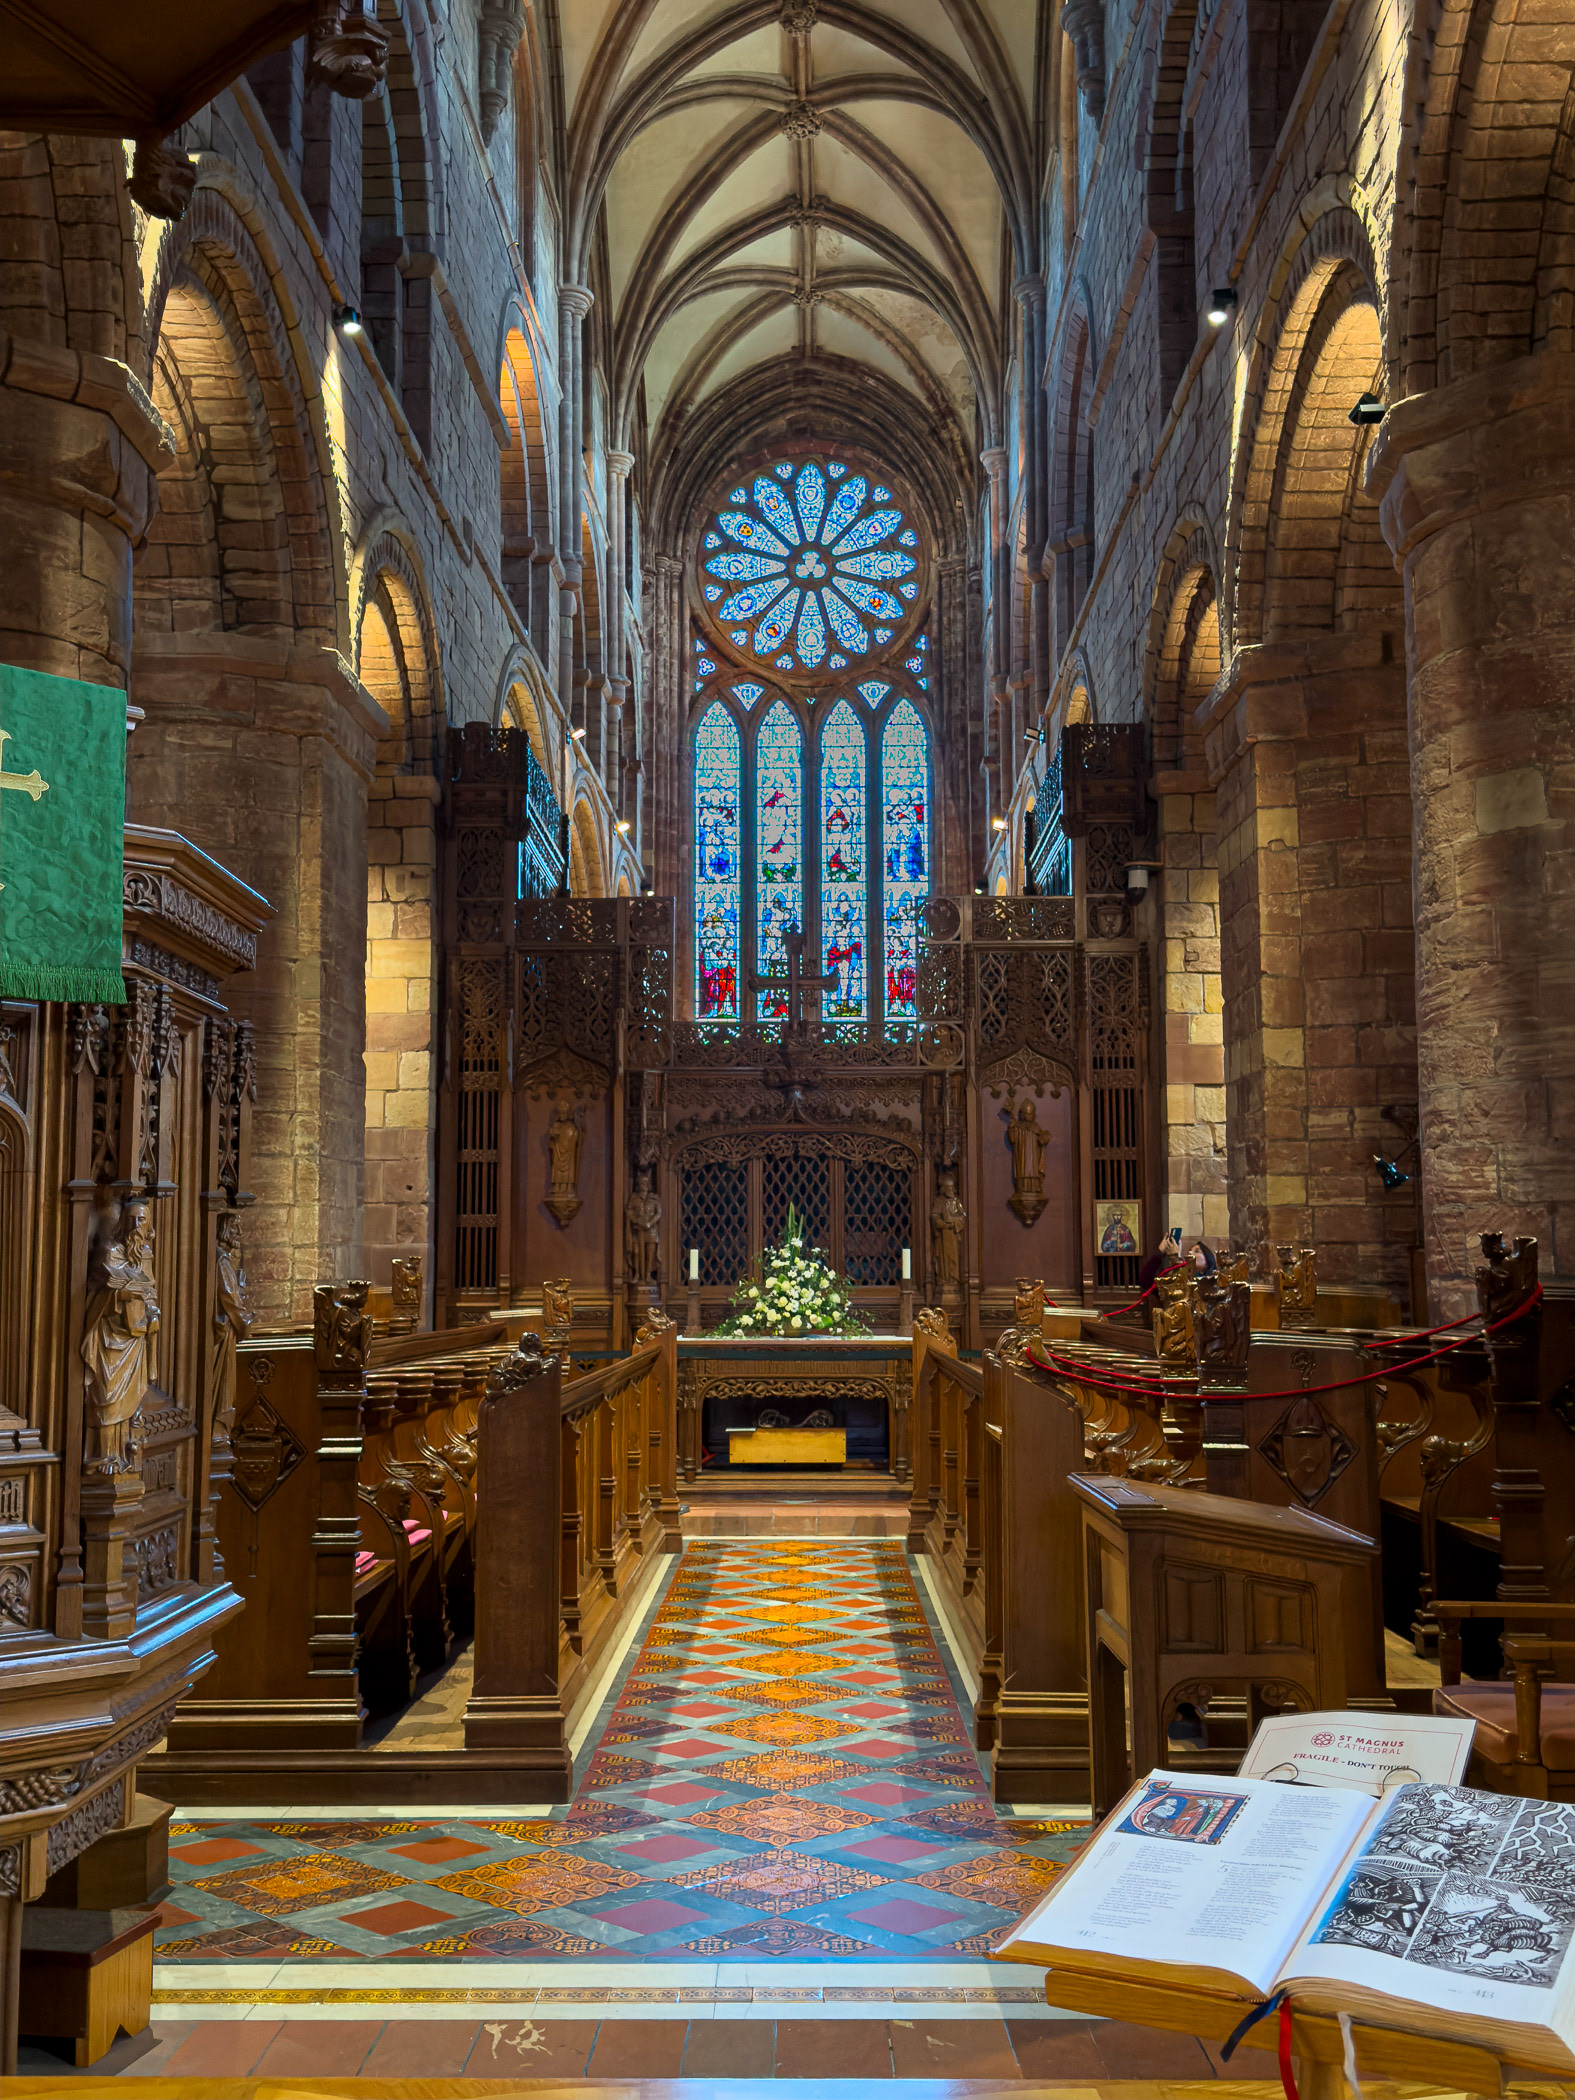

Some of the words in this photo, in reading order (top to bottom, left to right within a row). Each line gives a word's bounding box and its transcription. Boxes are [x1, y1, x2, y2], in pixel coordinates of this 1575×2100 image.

[1337, 1741, 1401, 1755] CATHEDRAL
[1338, 1734, 1353, 1742] ST
[1355, 1738, 1405, 1748] MAGNUS
[1293, 1753, 1340, 1764] FRAGILE
